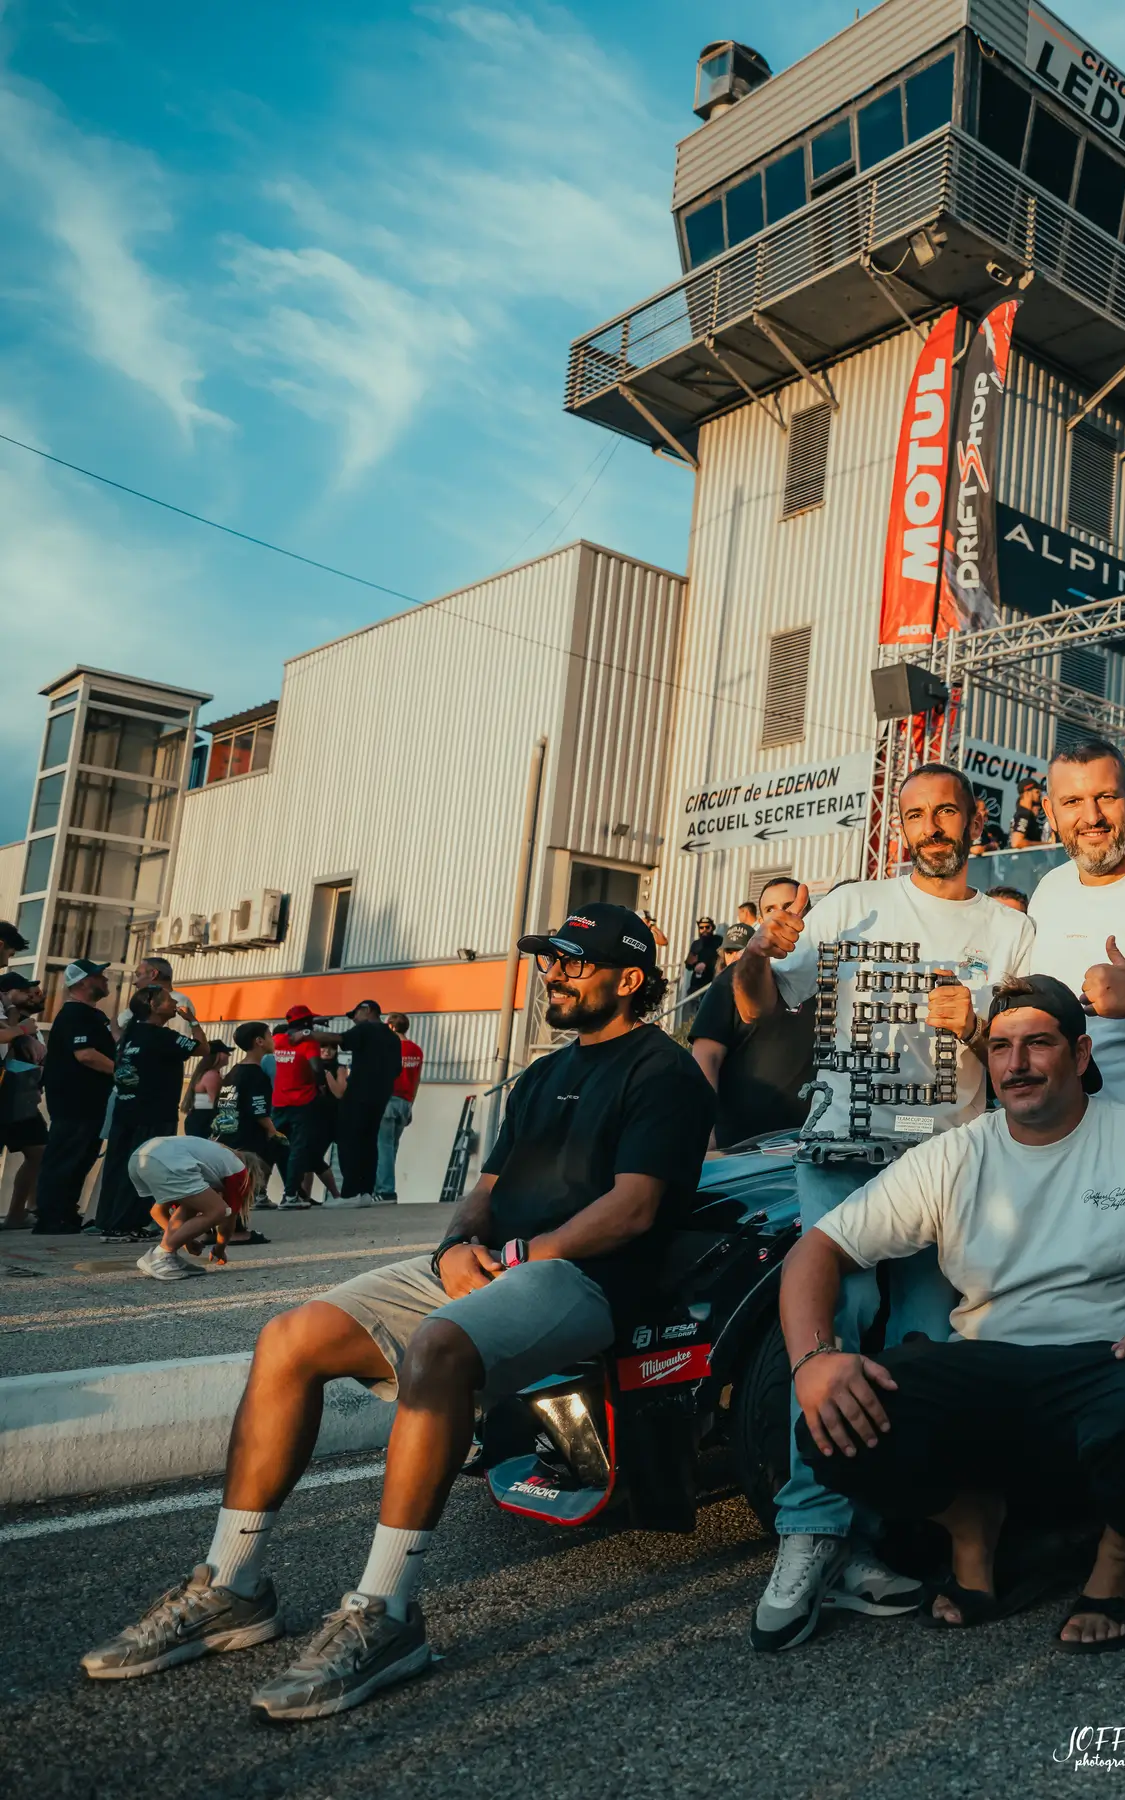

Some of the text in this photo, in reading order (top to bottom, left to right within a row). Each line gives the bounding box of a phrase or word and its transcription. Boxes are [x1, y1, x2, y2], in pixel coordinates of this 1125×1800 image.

[901, 357, 946, 585] MOTUL
[956, 372, 991, 589] DRIFTSHOP
[685, 766, 840, 814] CIRCUIT de LEDENON
[687, 791, 867, 837] ACCUEIL SECRETERIAT
[677, 1330, 697, 1338] DRIFT
[639, 1350, 692, 1379] Milwaukee
